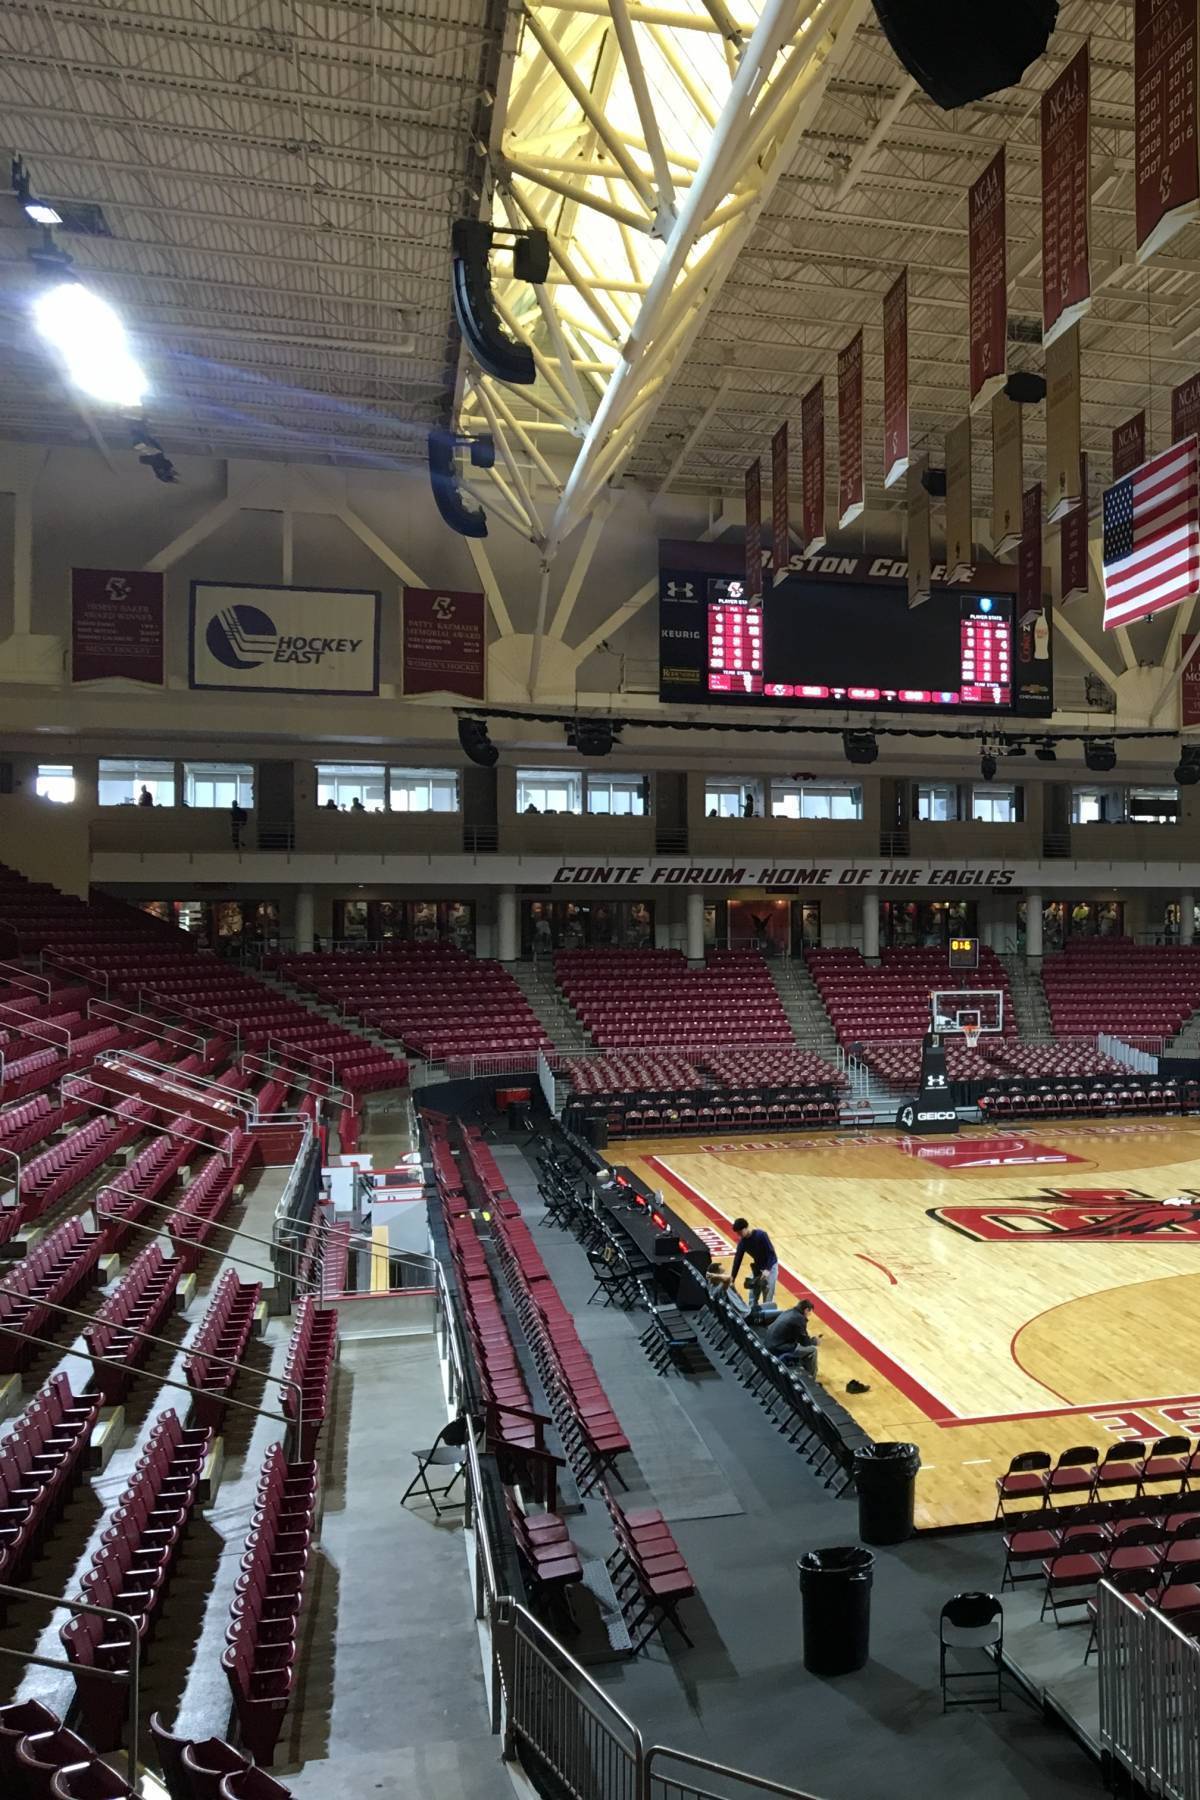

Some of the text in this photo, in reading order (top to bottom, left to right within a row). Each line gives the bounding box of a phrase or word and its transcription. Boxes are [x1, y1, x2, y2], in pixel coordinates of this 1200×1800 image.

[1147, 19, 1184, 64] HOCKEY
[1118, 424, 1138, 448] NCAA
[661, 630, 700, 639] KEURIG
[279, 635, 363, 654] HOCKEY
[273, 649, 325, 665] EAST
[552, 866, 642, 884] CONTE
[650, 867, 745, 884] FORUM
[757, 868, 831, 885] HOME
[838, 868, 873, 885] OF
[879, 869, 920, 885] THE
[927, 869, 1016, 886] EAGLES
[917, 1111, 956, 1121] GEICO
[949, 1155, 1068, 1168] ACC
